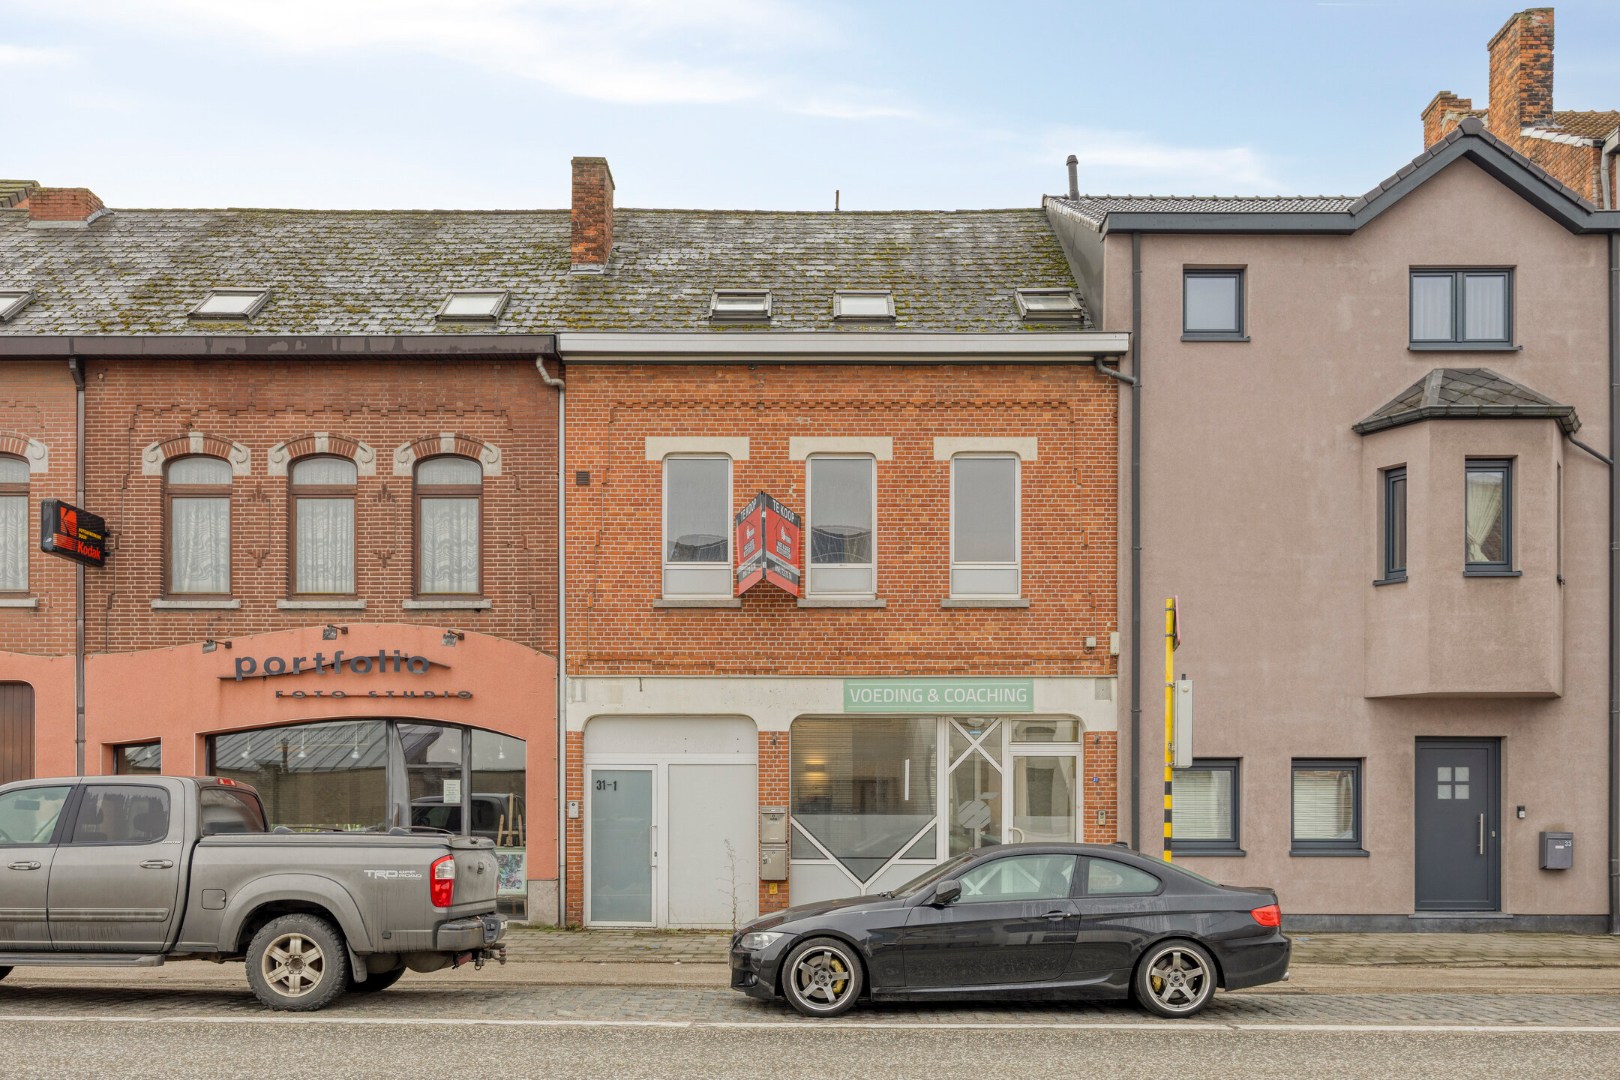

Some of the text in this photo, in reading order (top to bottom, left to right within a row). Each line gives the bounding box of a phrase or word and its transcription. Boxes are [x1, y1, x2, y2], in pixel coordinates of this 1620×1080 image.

[740, 498, 757, 521] TE KOOP
[772, 499, 795, 523] TE KOOP
[77, 540, 101, 560] Kodak
[234, 649, 430, 681] portfolio
[275, 690, 473, 699] FOTO STUDIO
[849, 688, 1027, 703] VOEDING & COACHING
[596, 779, 617, 791] 31-1
[363, 869, 399, 879] TRD
